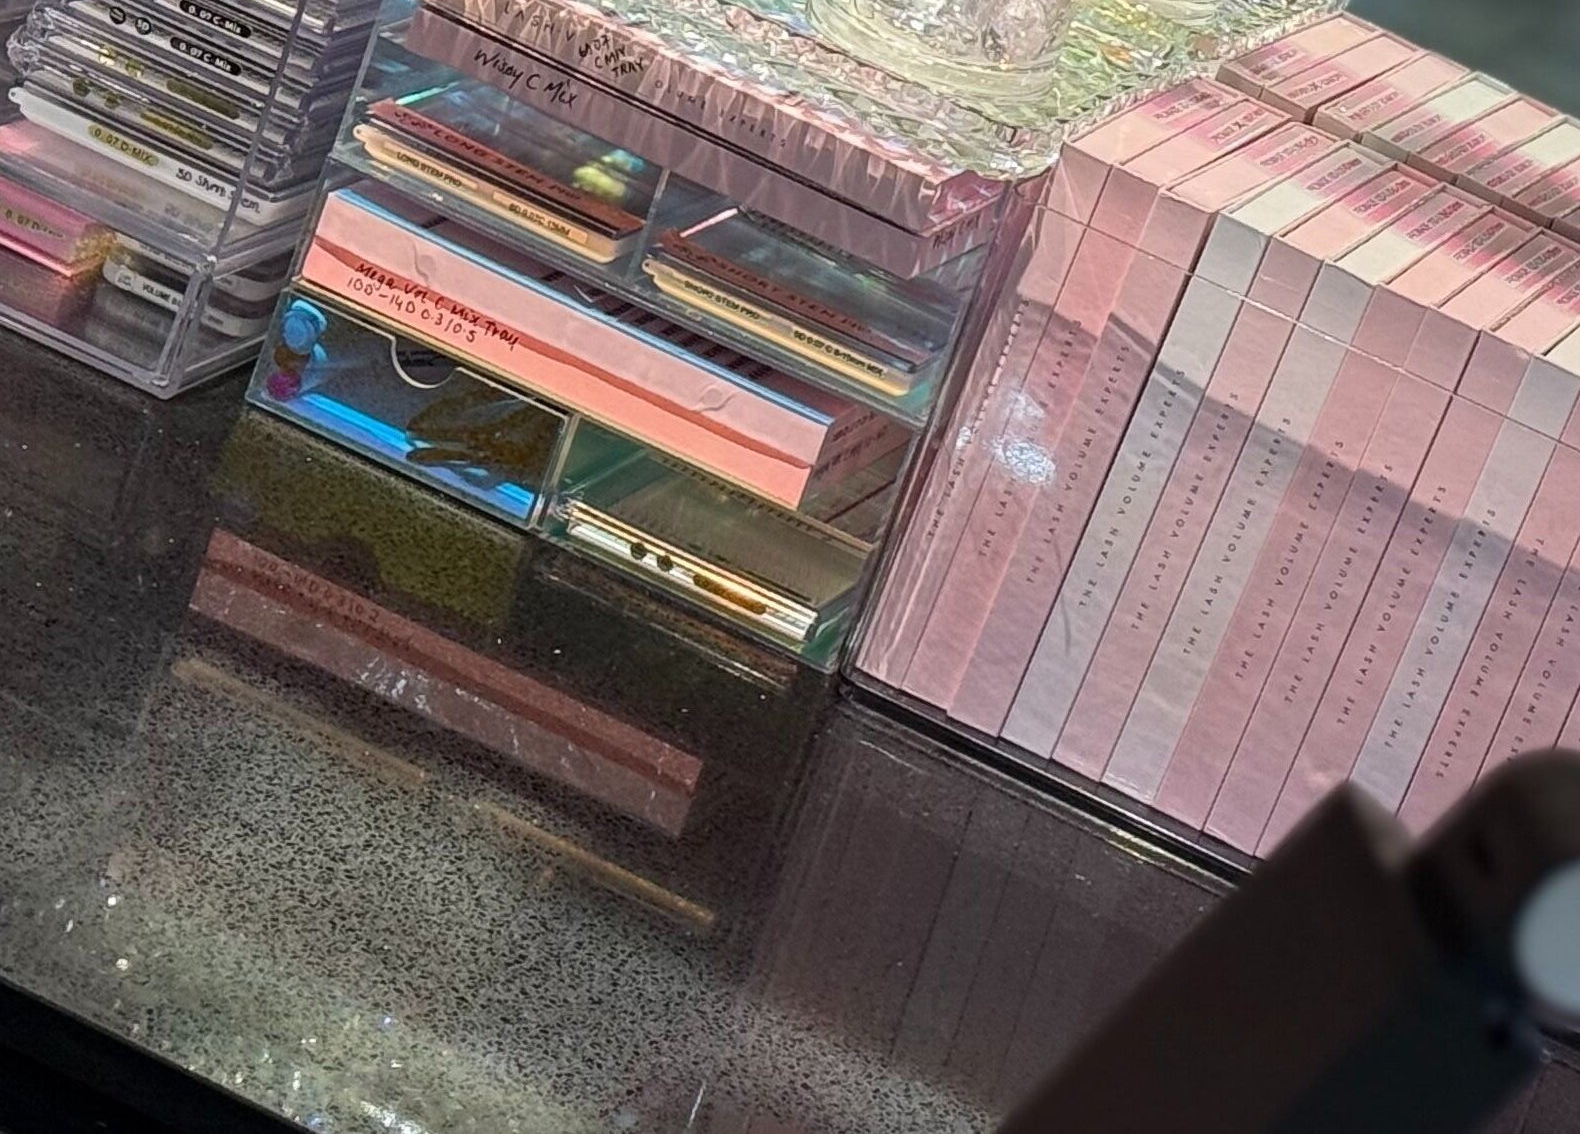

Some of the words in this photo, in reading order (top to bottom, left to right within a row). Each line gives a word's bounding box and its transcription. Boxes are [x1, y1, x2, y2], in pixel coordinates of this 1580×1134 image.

[524, 70, 542, 91] C
[540, 71, 582, 111] Mix
[394, 151, 420, 169] LONG
[140, 281, 171, 303] VOLUME
[350, 260, 400, 298] Mega
[449, 301, 482, 326] Mix
[479, 318, 521, 352] Tray
[1041, 502, 1066, 545] LASH
[1062, 425, 1098, 492] VOLUME
[1093, 342, 1132, 417] EXPERTS
[1094, 525, 1120, 568] LASH
[1116, 449, 1152, 516] VOLUME
[1148, 367, 1186, 440] EXPERTS
[1147, 548, 1173, 591] LASH
[1169, 472, 1205, 540] VOLUME
[1201, 390, 1240, 463] EXPERTS
[1198, 573, 1224, 616] LASH
[1221, 496, 1257, 564] VOLUME
[1254, 415, 1292, 488] EXPERTS
[1251, 596, 1277, 640] LASH
[1274, 519, 1310, 588] VOLUME
[1306, 438, 1345, 511] EXPERTS
[1301, 621, 1326, 664] LASH
[1323, 545, 1359, 612] VOLUME
[1356, 462, 1395, 535] EXPERTS
[1353, 642, 1379, 686] LASH
[1376, 566, 1412, 634] VOLUME
[1409, 483, 1448, 557] EXPERTS
[1401, 666, 1427, 709] LASH
[1424, 589, 1461, 657] VOLUME
[1458, 506, 1497, 580] EXPERTS
[1500, 577, 1527, 621] LASH
[1553, 603, 1580, 648] LASH
[1467, 629, 1505, 699] VOLUME
[1520, 656, 1557, 726] VOLUME
[1432, 706, 1472, 781] EXPERTS
